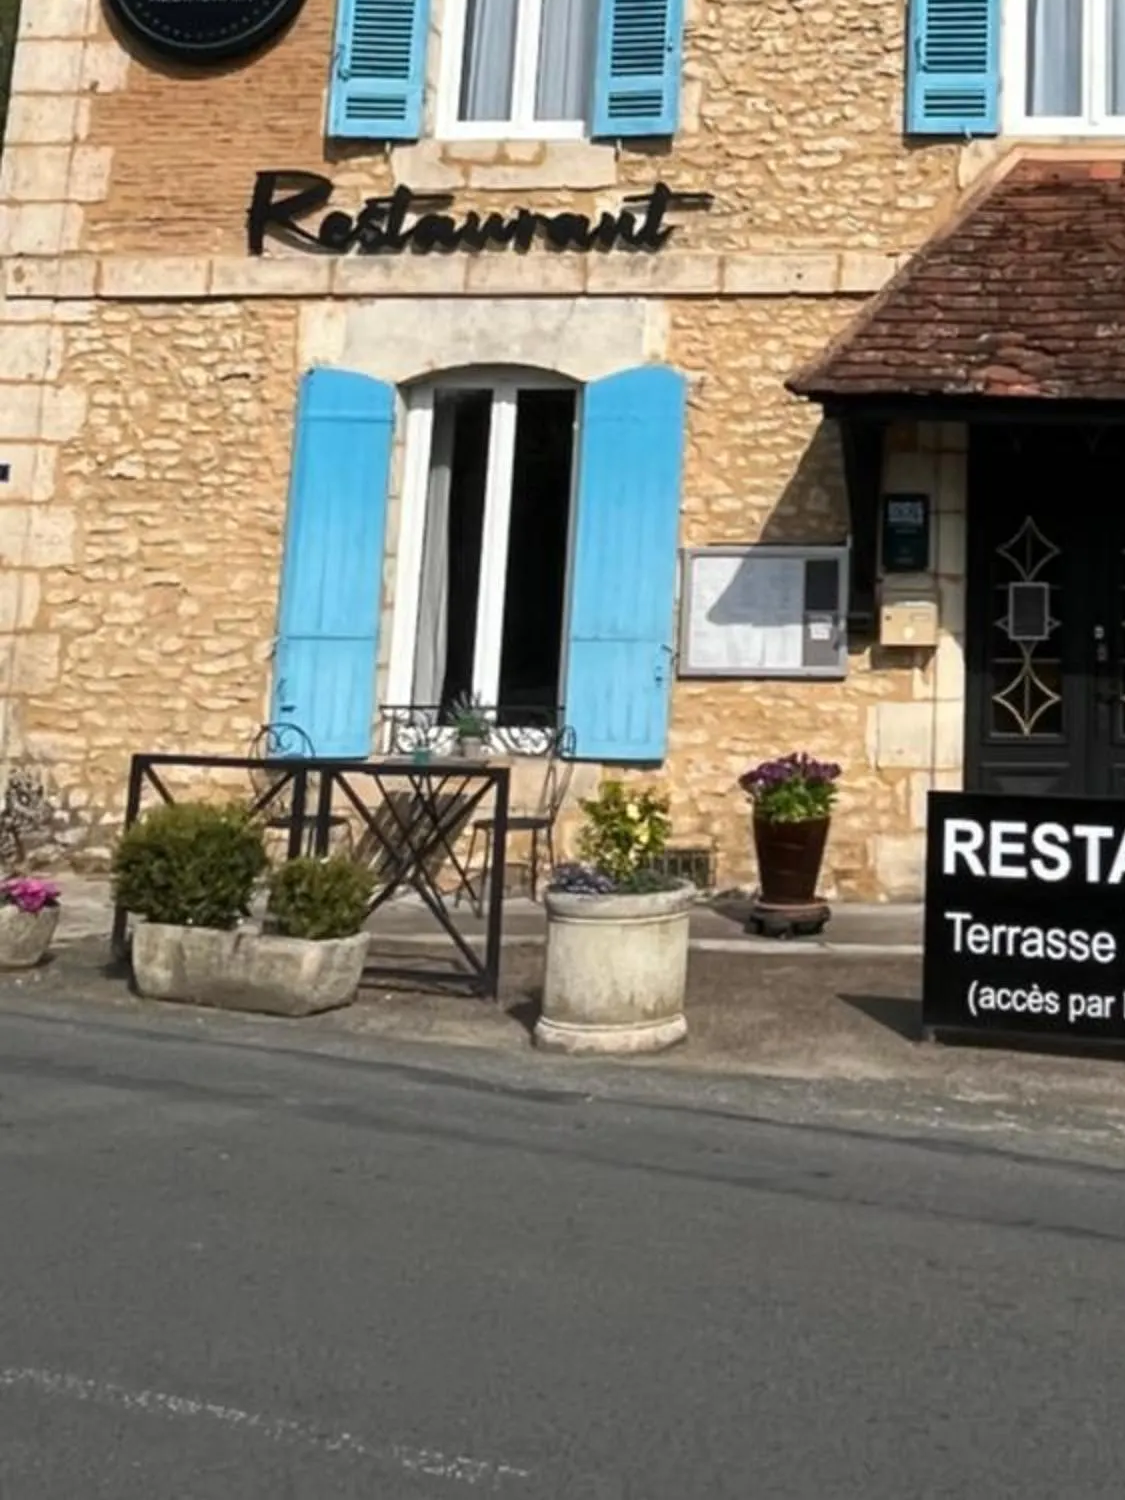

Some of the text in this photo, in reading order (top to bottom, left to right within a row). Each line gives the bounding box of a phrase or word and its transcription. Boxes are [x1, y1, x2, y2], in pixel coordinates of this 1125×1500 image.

[247, 170, 715, 256] Restaurant
[945, 912, 1116, 963] Terrasse
[967, 981, 1060, 1015] (accès
[1068, 992, 1115, 1023] par
